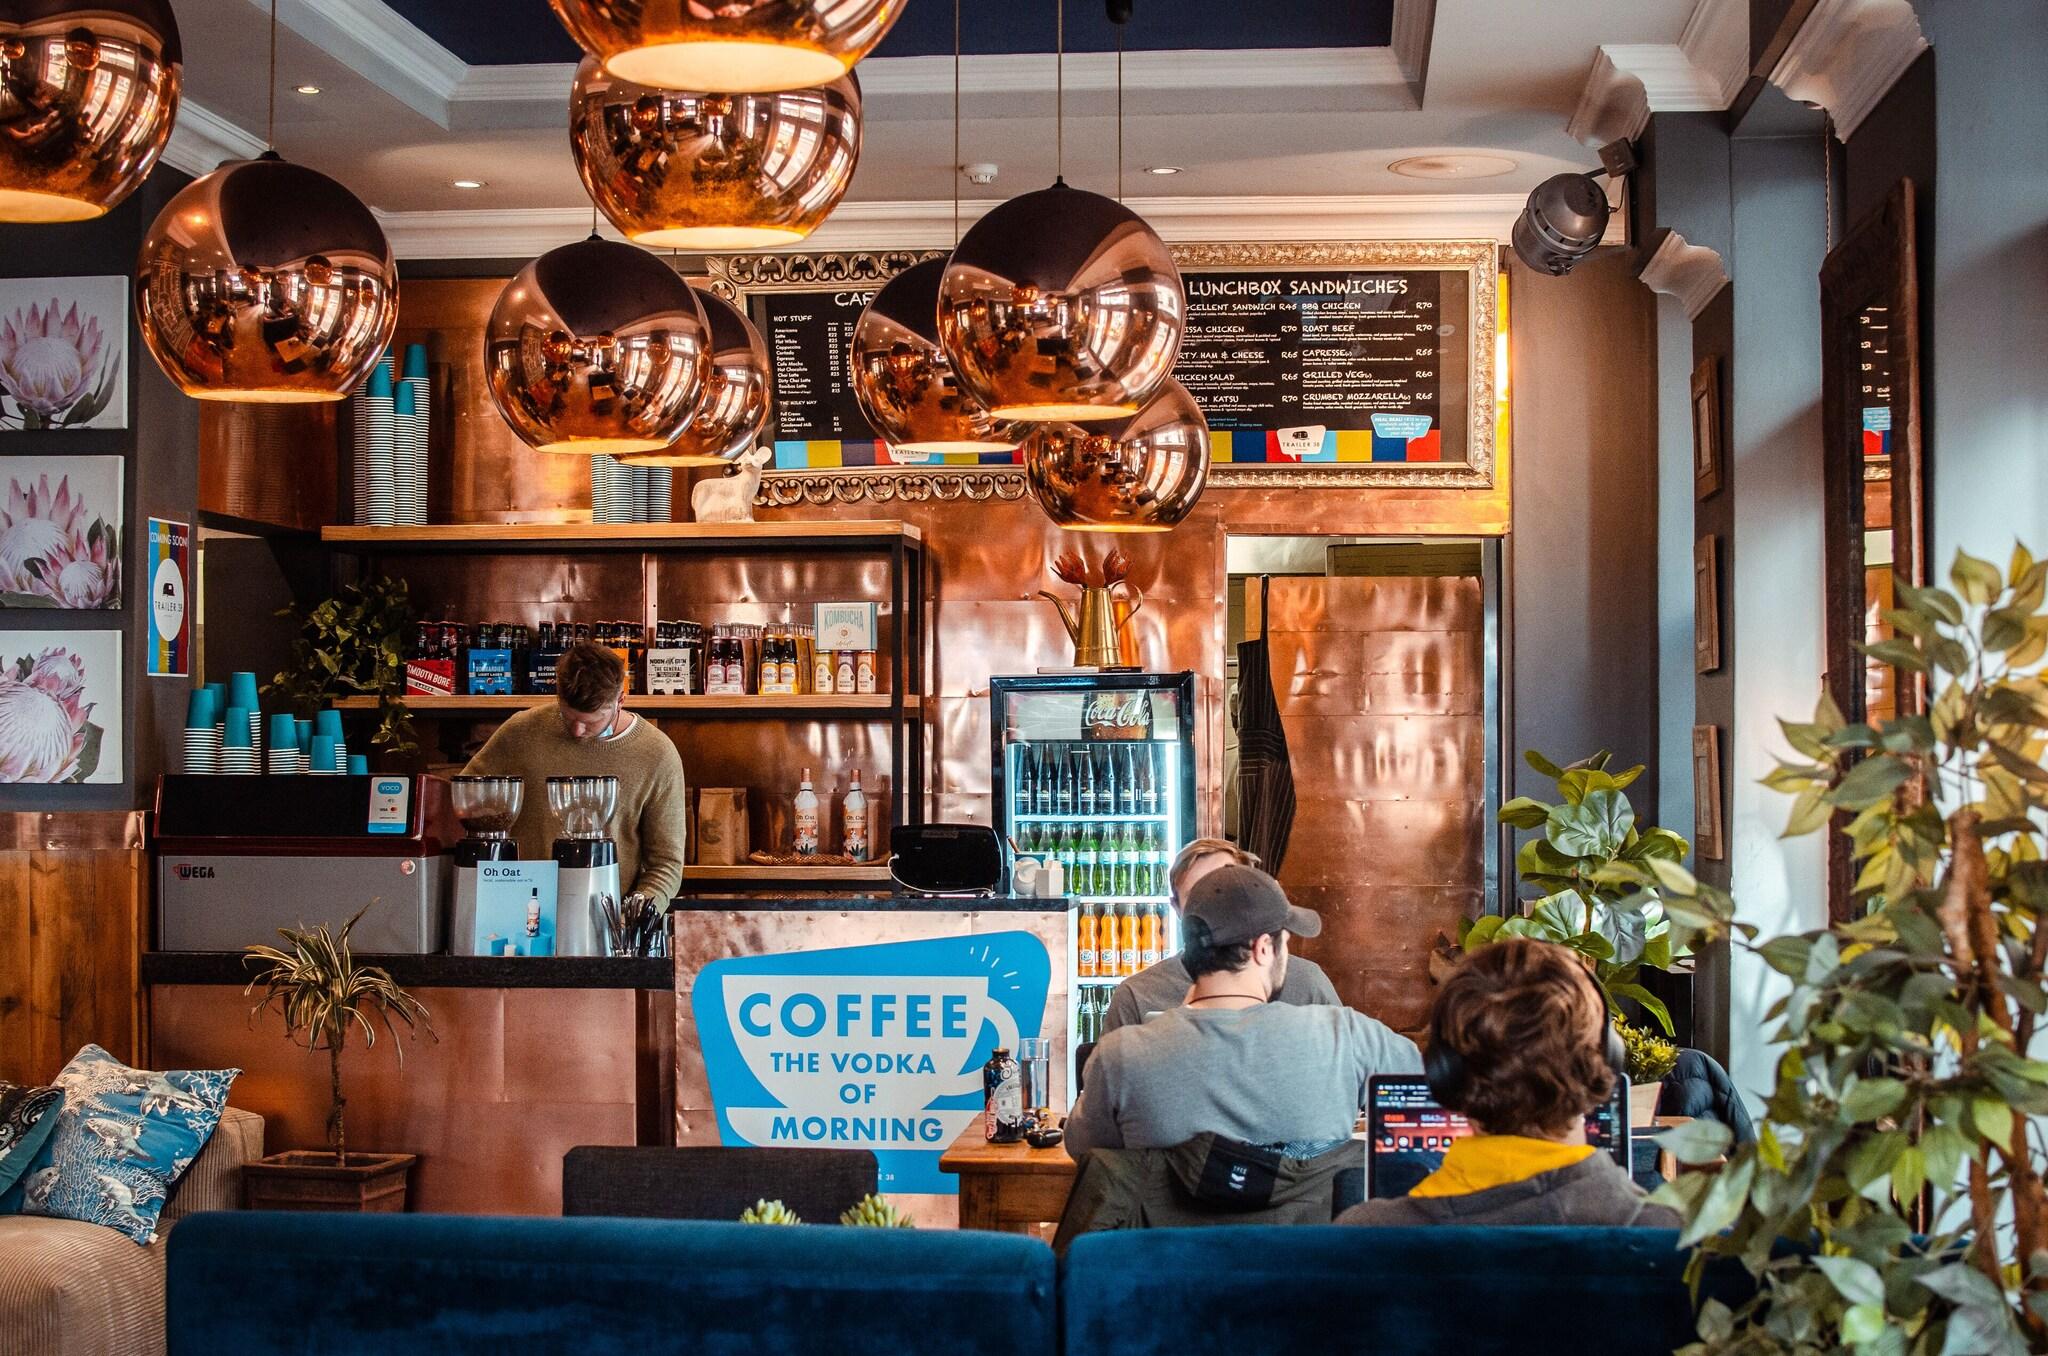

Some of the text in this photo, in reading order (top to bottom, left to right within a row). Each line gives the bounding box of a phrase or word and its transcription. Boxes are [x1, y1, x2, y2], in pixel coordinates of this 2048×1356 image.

[1189, 279, 1408, 297] LUNCHBOX SANDWICHES
[834, 292, 875, 307] CAF
[1232, 303, 1276, 311] SANDWICH
[1278, 303, 1297, 311] R45
[1301, 301, 1433, 311] BBQ CHICKEN R70
[1184, 326, 1203, 334] ISSA
[1281, 325, 1298, 333] R70
[1302, 323, 1433, 333] ROAST BEEF R70
[1178, 352, 1197, 360] RTY
[1200, 352, 1218, 360] HAM
[1231, 351, 1265, 359] CHEESE
[1281, 350, 1299, 359] R65
[1209, 373, 1235, 381] SALAD
[1281, 373, 1299, 381] R65
[1302, 371, 1342, 380] GRILLED
[1415, 371, 1433, 380] R60
[1213, 396, 1239, 404] KATSU
[1281, 396, 1298, 404] R70
[1302, 393, 1343, 402] CRUMBED
[1415, 393, 1433, 402] R65
[151, 532, 172, 545] COMING
[155, 601, 177, 612] TRAILER
[824, 610, 864, 632] KOMBUCHA
[407, 664, 451, 688] SMOOTH BORE
[1085, 700, 1150, 728] Coca-Cola
[180, 866, 215, 879] WEGA
[483, 867, 521, 877] Oh Oat
[739, 993, 967, 1038] COFFEE
[770, 1052, 936, 1074] THE VODKA
[839, 1083, 876, 1104] OF
[771, 1116, 944, 1142] MORNING
